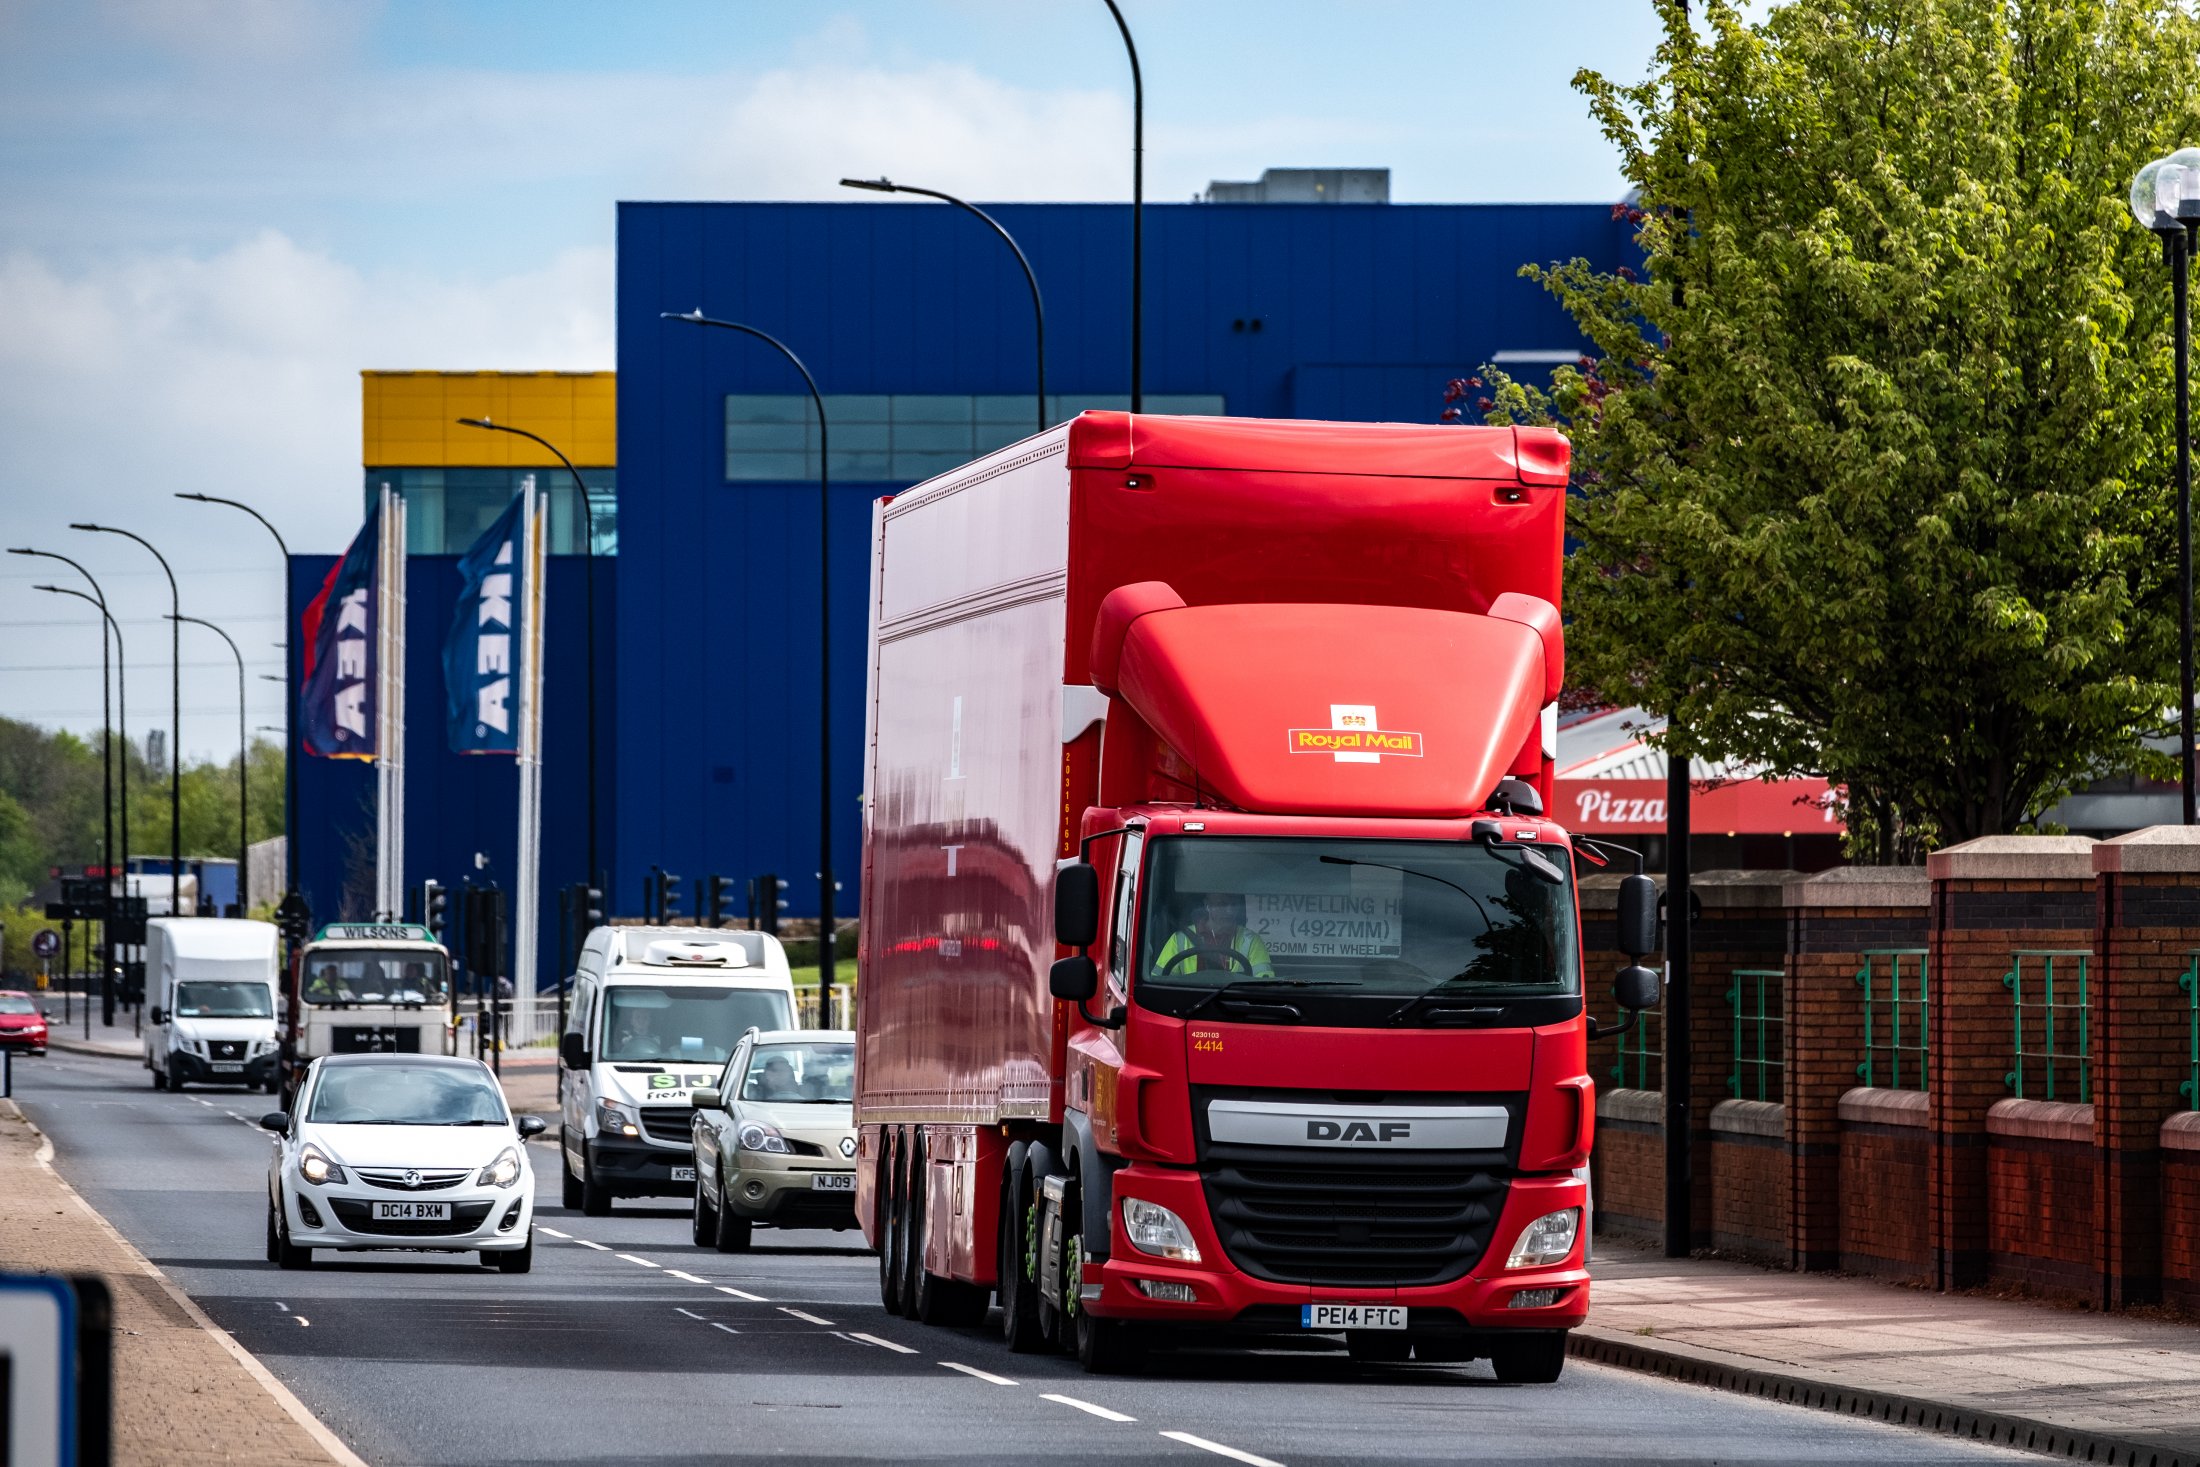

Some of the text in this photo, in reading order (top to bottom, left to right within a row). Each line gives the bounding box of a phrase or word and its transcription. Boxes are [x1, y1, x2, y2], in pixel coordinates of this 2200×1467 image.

[334, 588, 368, 738] KEA
[1299, 732, 1413, 750] Royal Mail
[1576, 788, 1668, 822] Pizza
[1256, 895, 1375, 915] TRAVELLING
[344, 927, 409, 939] WILSONS
[1290, 918, 1390, 939] (4927MM)
[1264, 942, 1379, 955] 250MM 5TH WHEEL
[355, 1034, 396, 1042] MAN
[1194, 1040, 1224, 1052] 4414
[1306, 1120, 1411, 1142] DAF
[818, 1175, 850, 1188] NJ09
[381, 1204, 443, 1218] DC14 BXM
[1318, 1307, 1400, 1326] PE14 FTC
